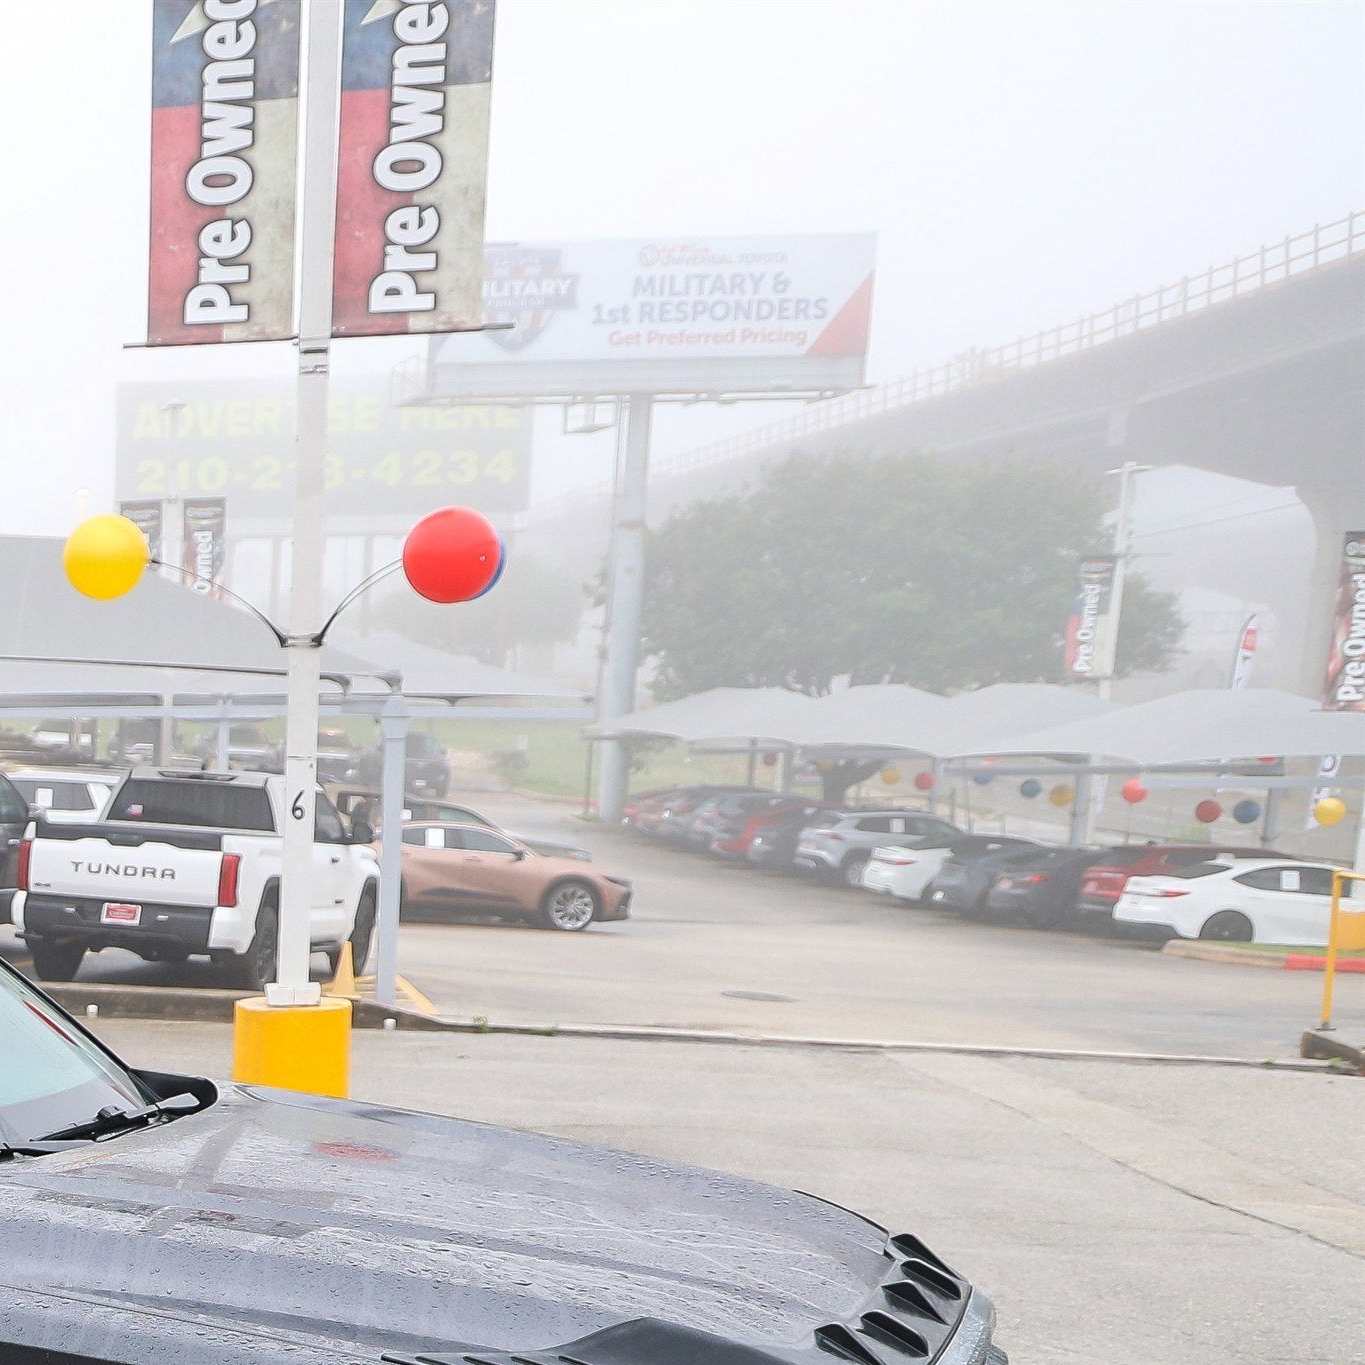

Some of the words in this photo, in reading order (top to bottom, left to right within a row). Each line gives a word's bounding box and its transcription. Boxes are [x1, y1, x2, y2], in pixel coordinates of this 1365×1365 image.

[372, 0, 450, 193] Owne
[183, 218, 253, 325] Pre
[369, 205, 440, 314] Pre
[483, 278, 573, 298] ILITARY
[633, 272, 766, 299] MILITARY
[772, 272, 793, 295] &
[592, 301, 631, 326] 1st
[639, 297, 829, 324] RESPONDERS
[608, 330, 642, 347] Get
[647, 328, 736, 346] Preferred
[740, 328, 809, 347] Pricing
[133, 395, 381, 440] ADVERSE
[135, 447, 519, 493] 210-23-4234
[1076, 583, 1101, 641] Owned
[291, 789, 304, 820] 6
[70, 860, 176, 880] TUNDRA
